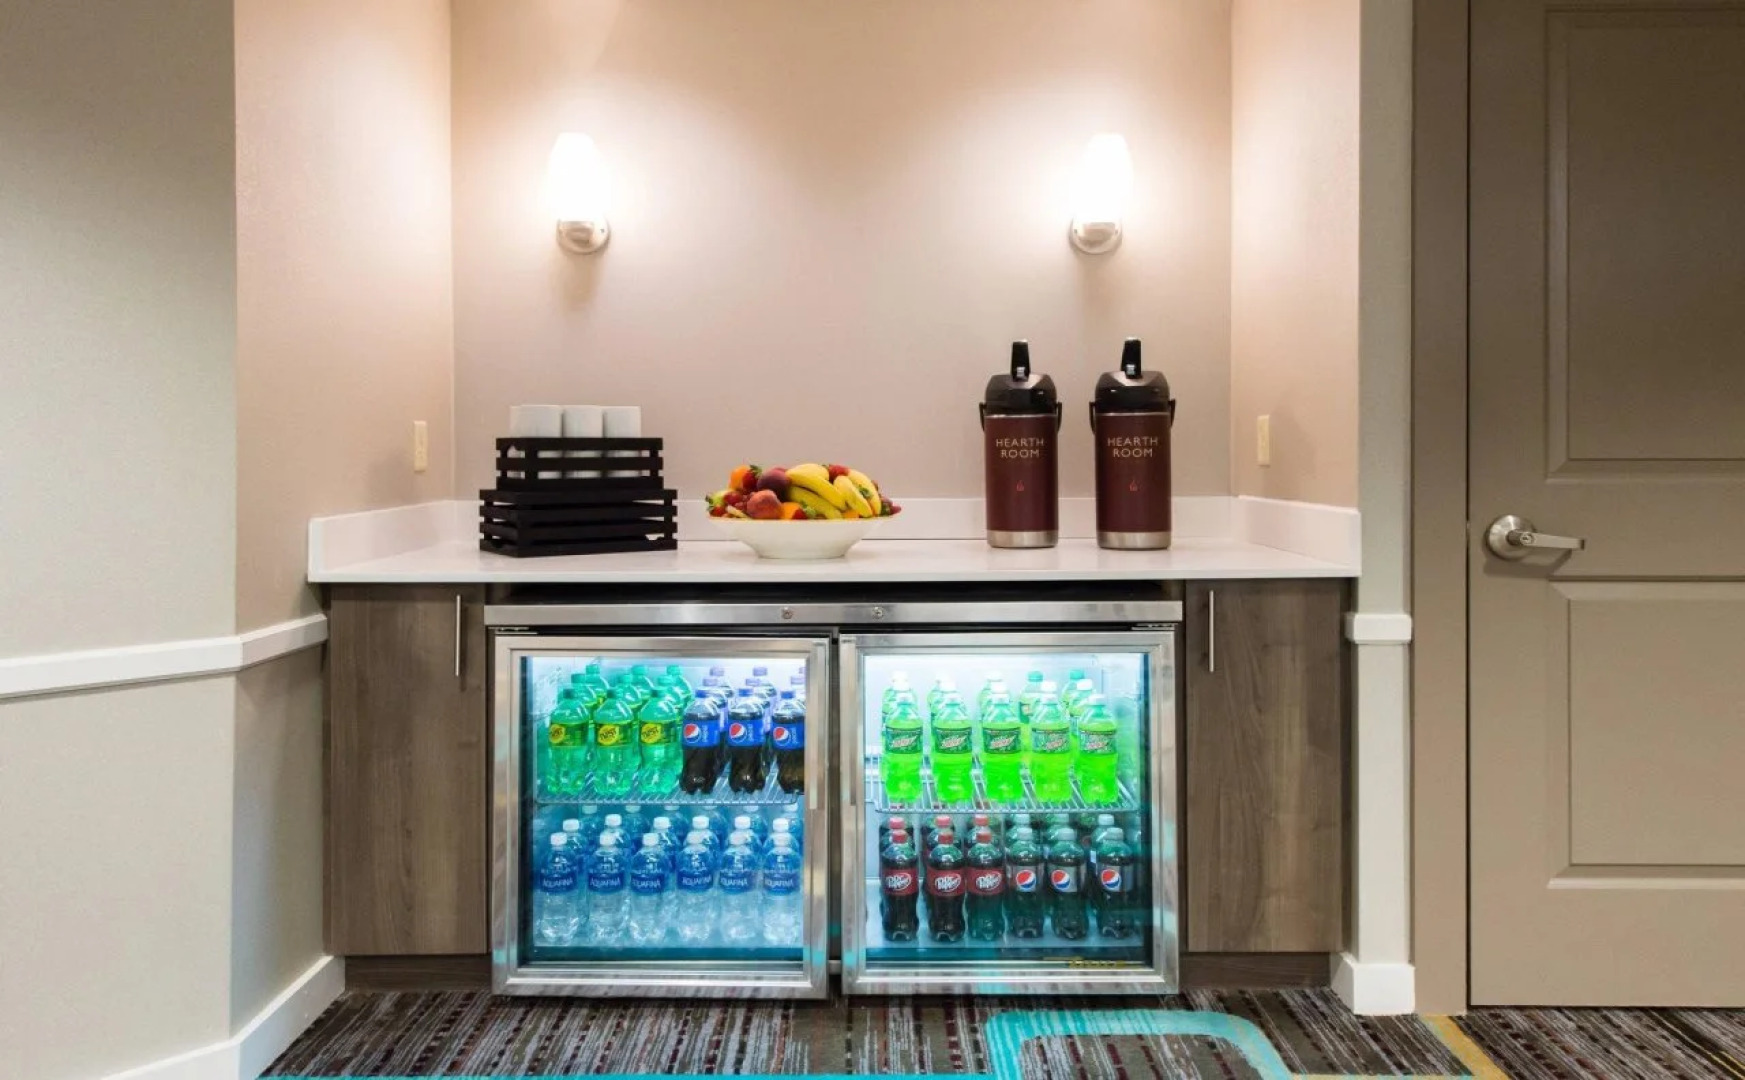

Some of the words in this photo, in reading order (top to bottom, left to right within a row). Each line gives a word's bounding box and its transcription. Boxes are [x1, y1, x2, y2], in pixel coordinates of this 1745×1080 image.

[996, 438, 1044, 448] HEARTH
[1107, 436, 1158, 447] HEARTH
[1001, 449, 1040, 459] ROOM
[1113, 448, 1153, 458] ROOM
